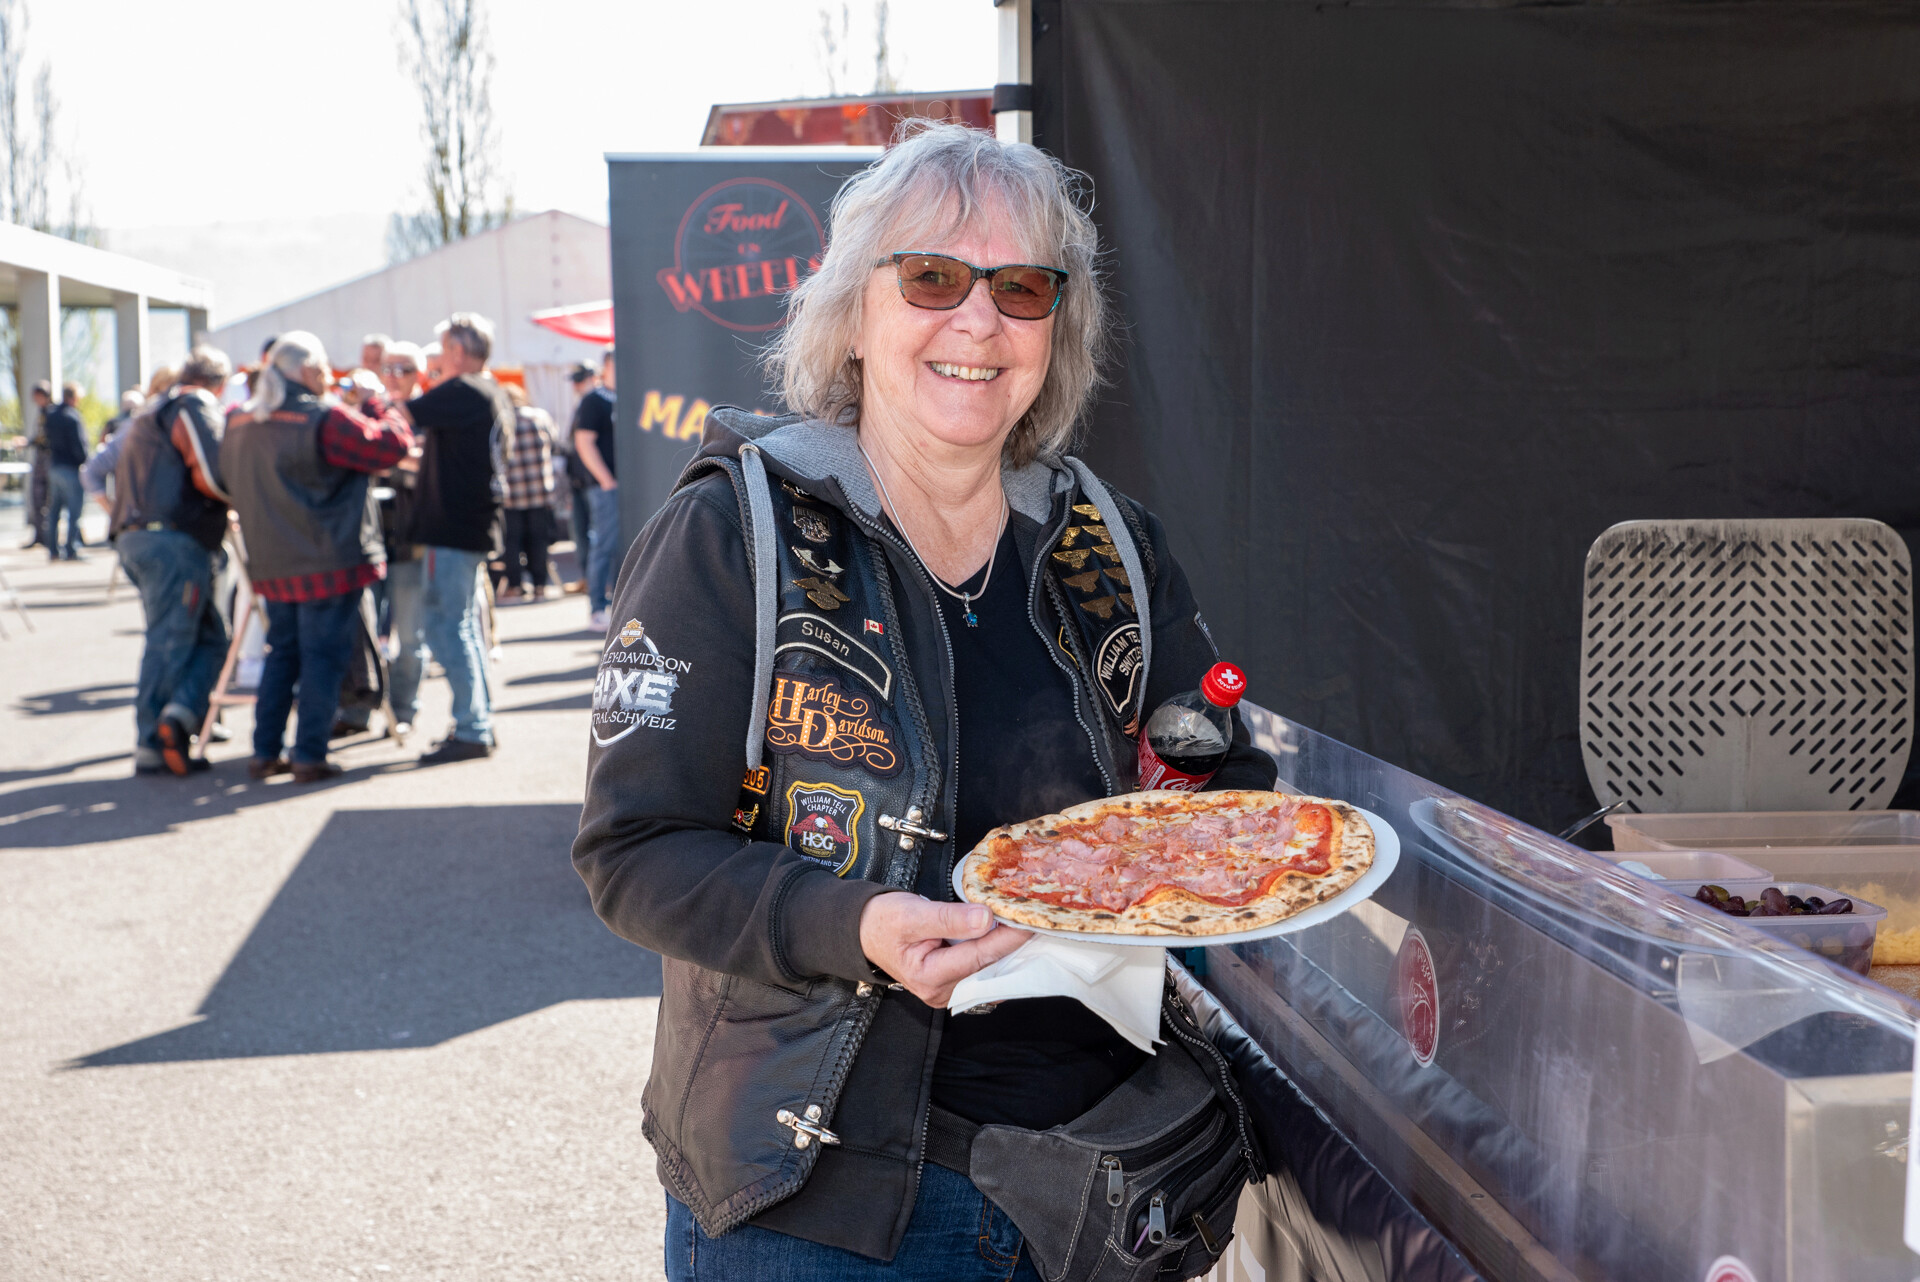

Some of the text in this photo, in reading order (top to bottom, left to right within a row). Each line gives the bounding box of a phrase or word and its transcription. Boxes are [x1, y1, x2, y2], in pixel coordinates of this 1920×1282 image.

[704, 199, 789, 234] Food
[639, 390, 709, 441] MA
[801, 621, 850, 656] Susan
[600, 651, 692, 674] LEY-DAVIDSON
[1100, 635, 1129, 681] WILLIAM
[592, 710, 678, 731] TRAL-SCHWEIZ
[801, 795, 848, 815] WILLIAM TELL
[806, 804, 838, 817] CHAPTER
